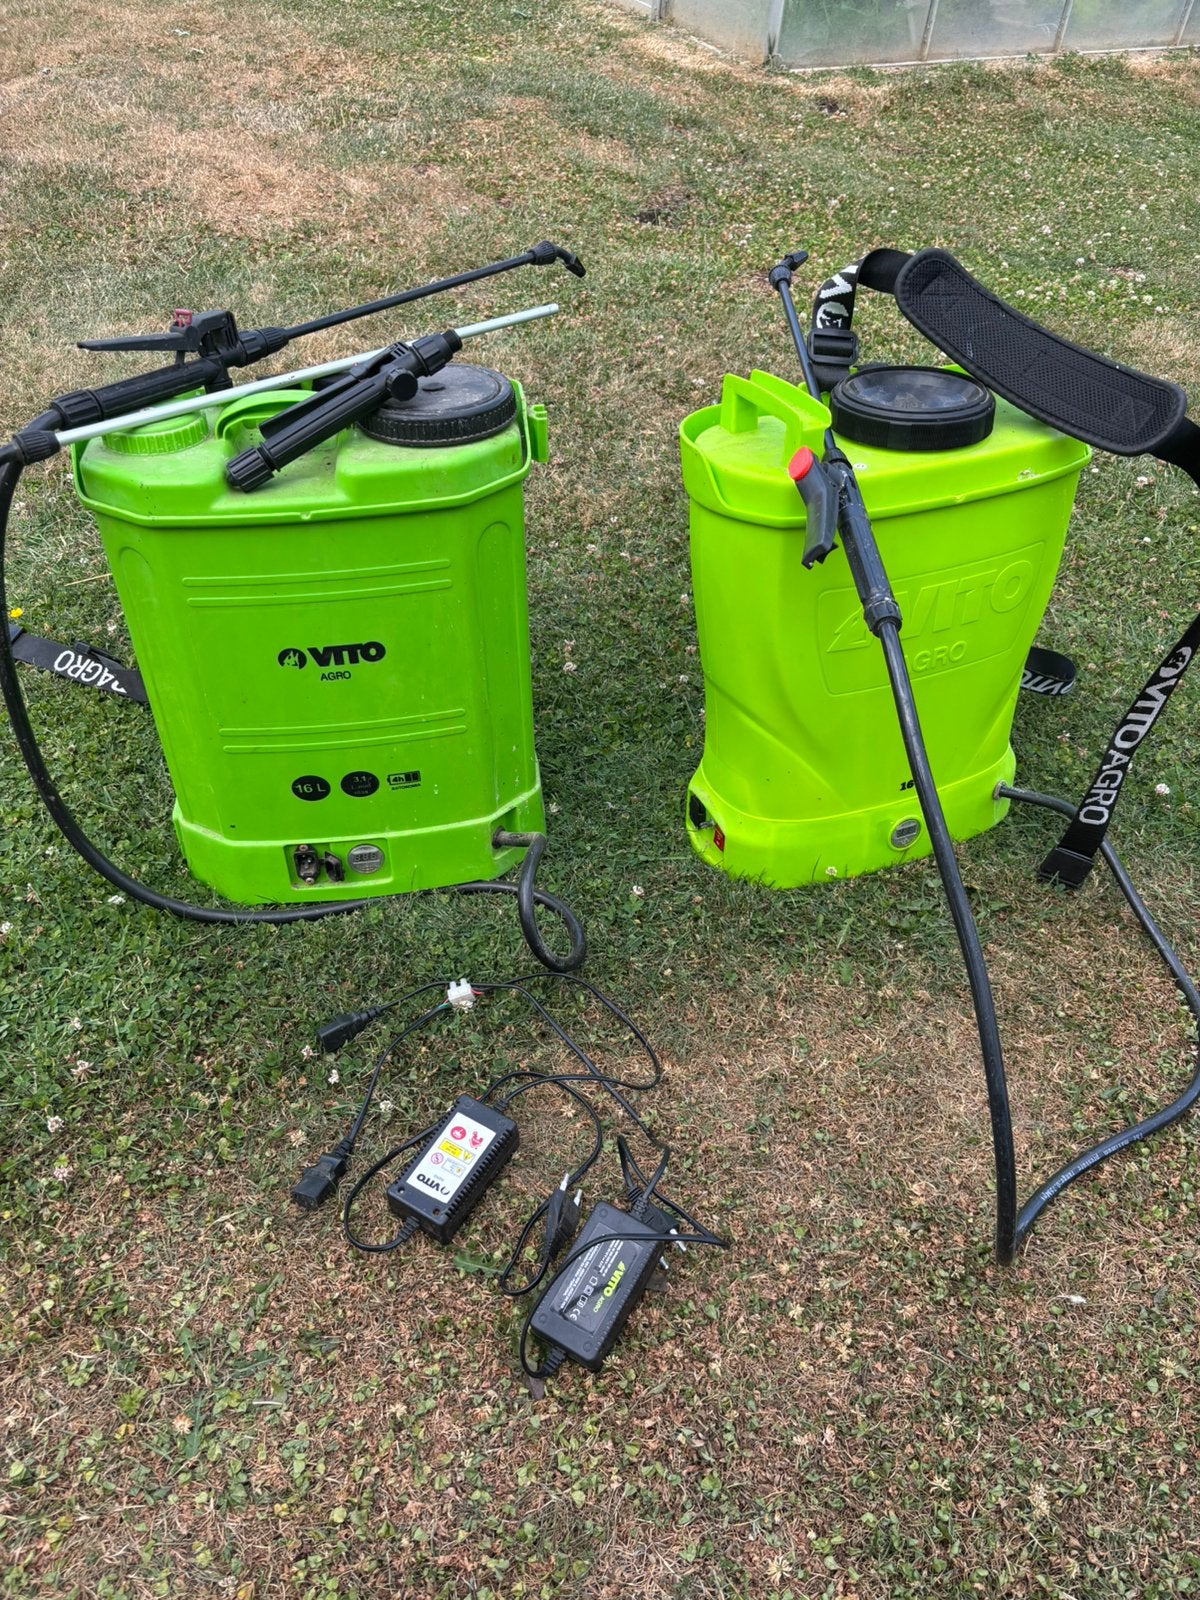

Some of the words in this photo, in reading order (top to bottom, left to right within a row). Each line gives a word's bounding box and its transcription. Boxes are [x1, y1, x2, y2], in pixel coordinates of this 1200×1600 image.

[307, 640, 386, 667] VITO
[904, 640, 967, 673] GRO
[53, 650, 115, 687] AGRO
[320, 670, 352, 682] AGRO
[1113, 677, 1178, 749] VITO
[295, 784, 313, 793] 16
[317, 784, 326, 792] L
[392, 774, 404, 783] 4h
[1078, 748, 1130, 826] AGRO
[416, 1173, 441, 1192] VITO
[603, 1269, 625, 1297] VITO
[593, 1295, 605, 1313] AGRO
